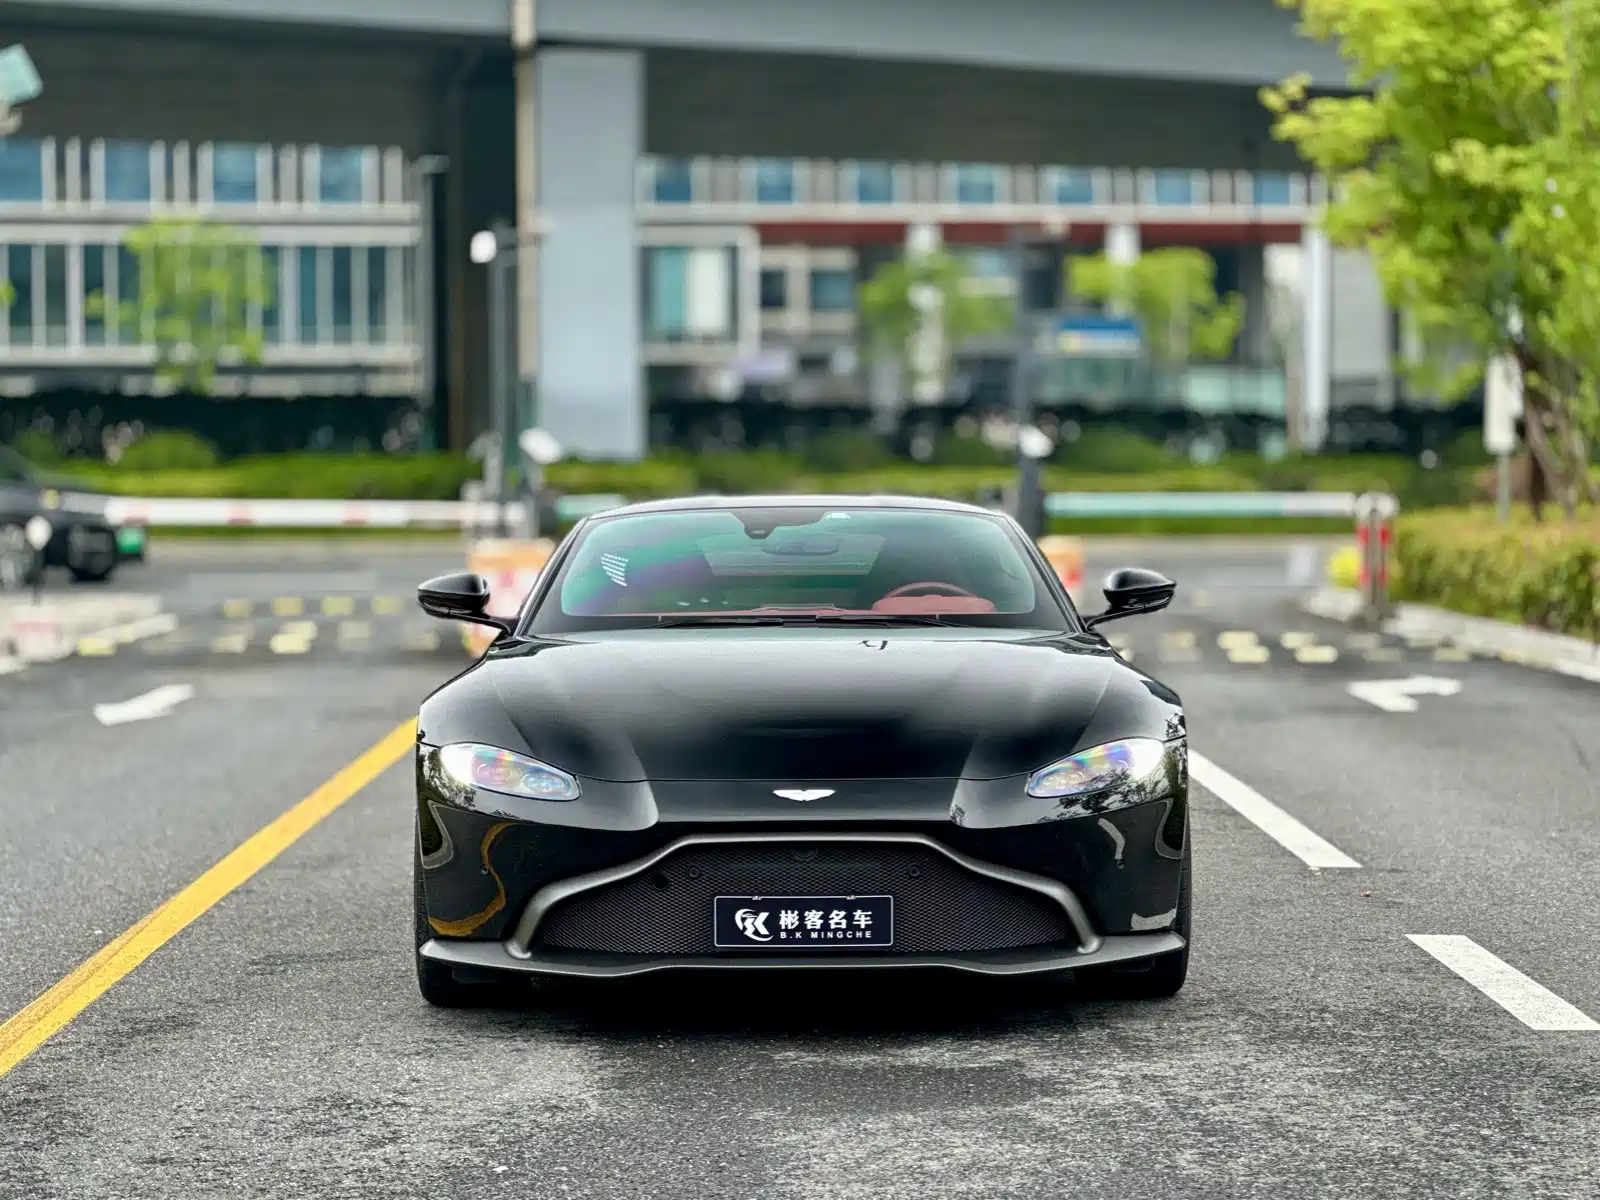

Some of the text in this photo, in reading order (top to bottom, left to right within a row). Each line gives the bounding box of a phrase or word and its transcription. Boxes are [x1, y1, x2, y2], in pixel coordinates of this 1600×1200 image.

[779, 909, 873, 930] 彬客名车
[780, 931, 872, 939] B.K MINGCHE
